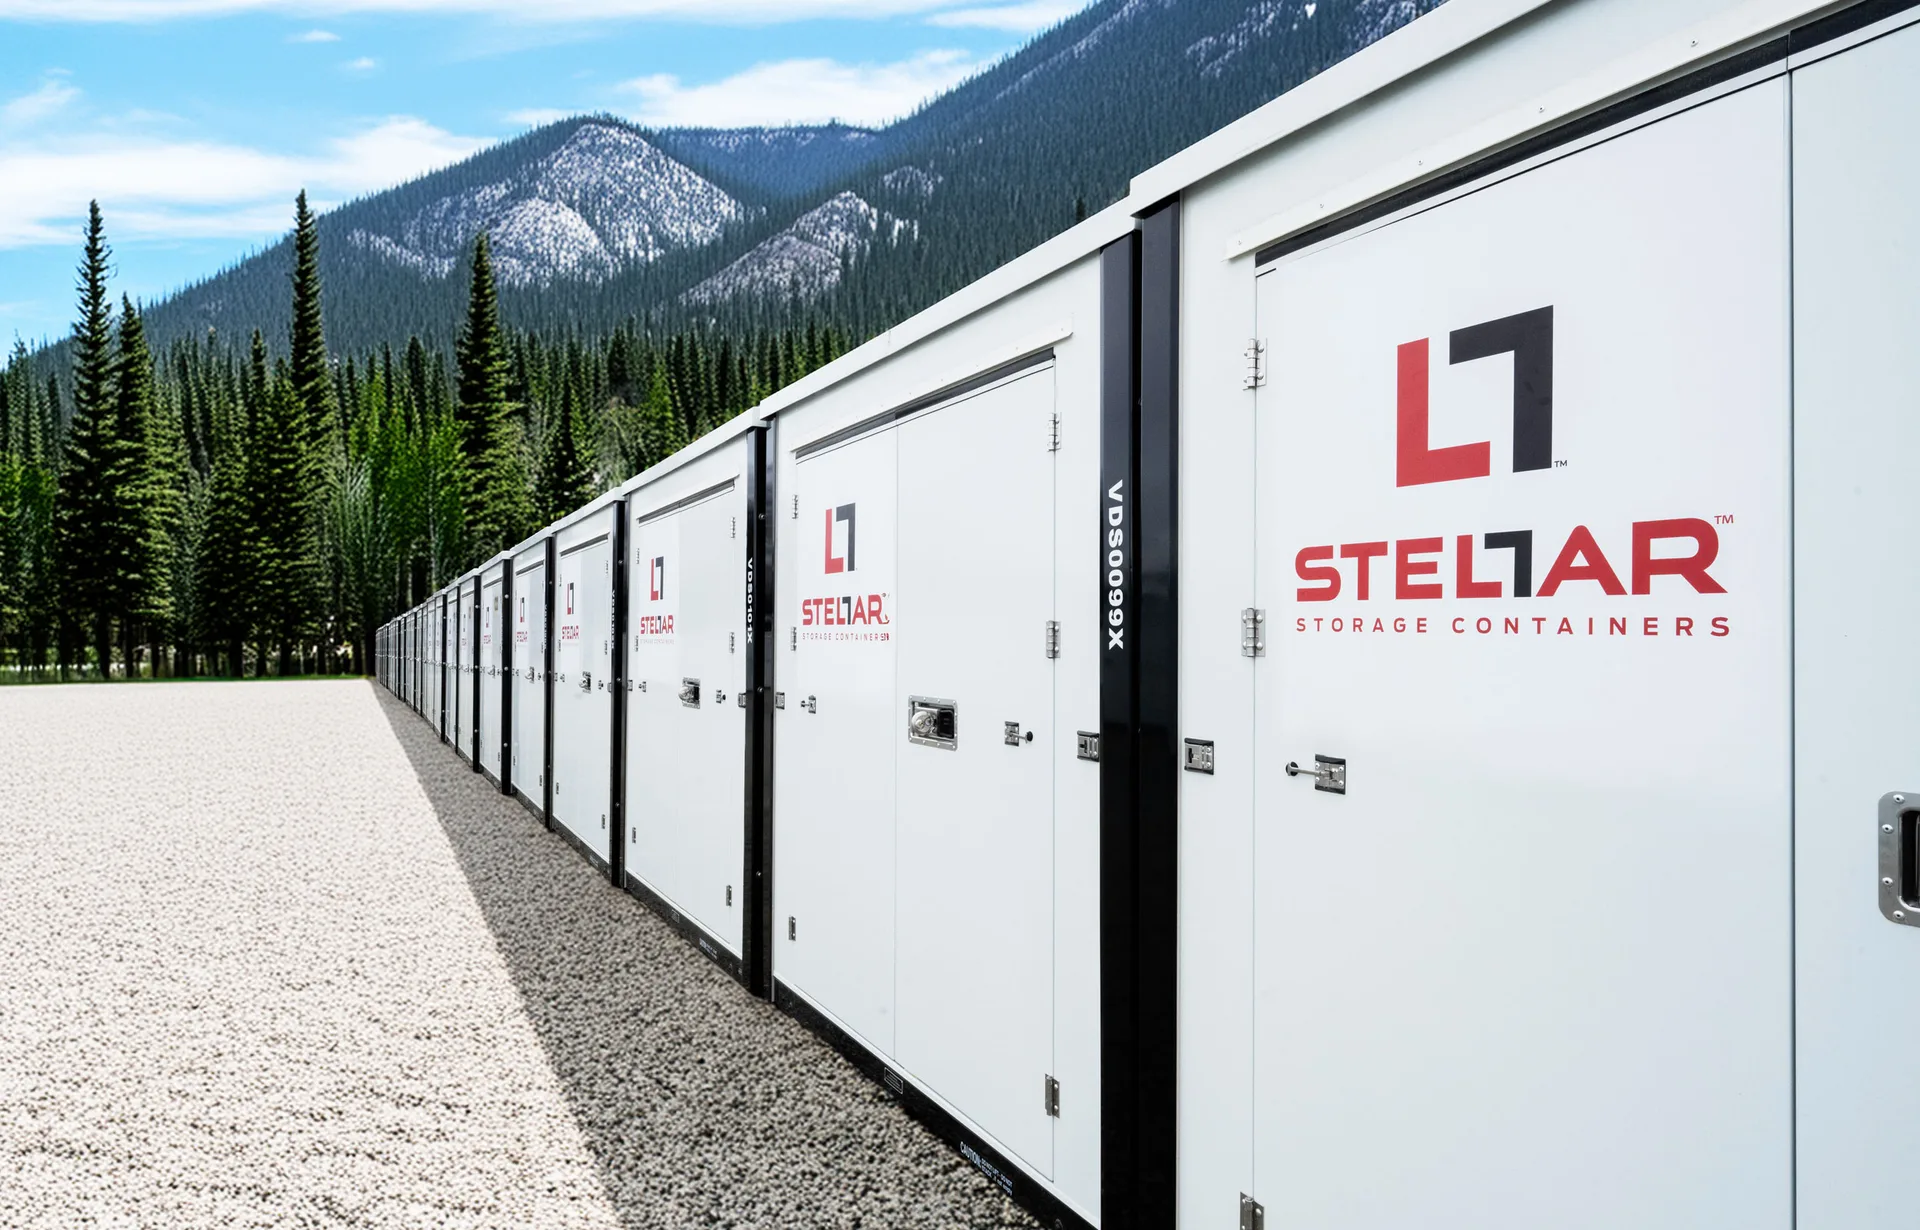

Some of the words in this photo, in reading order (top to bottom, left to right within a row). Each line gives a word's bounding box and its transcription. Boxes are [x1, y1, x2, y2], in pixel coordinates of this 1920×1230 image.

[1108, 479, 1124, 650] VDS0099X
[1295, 517, 1728, 602] STELLAR
[1296, 617, 1428, 634] STORAGE
[1452, 616, 1730, 637] CONTAINERS
